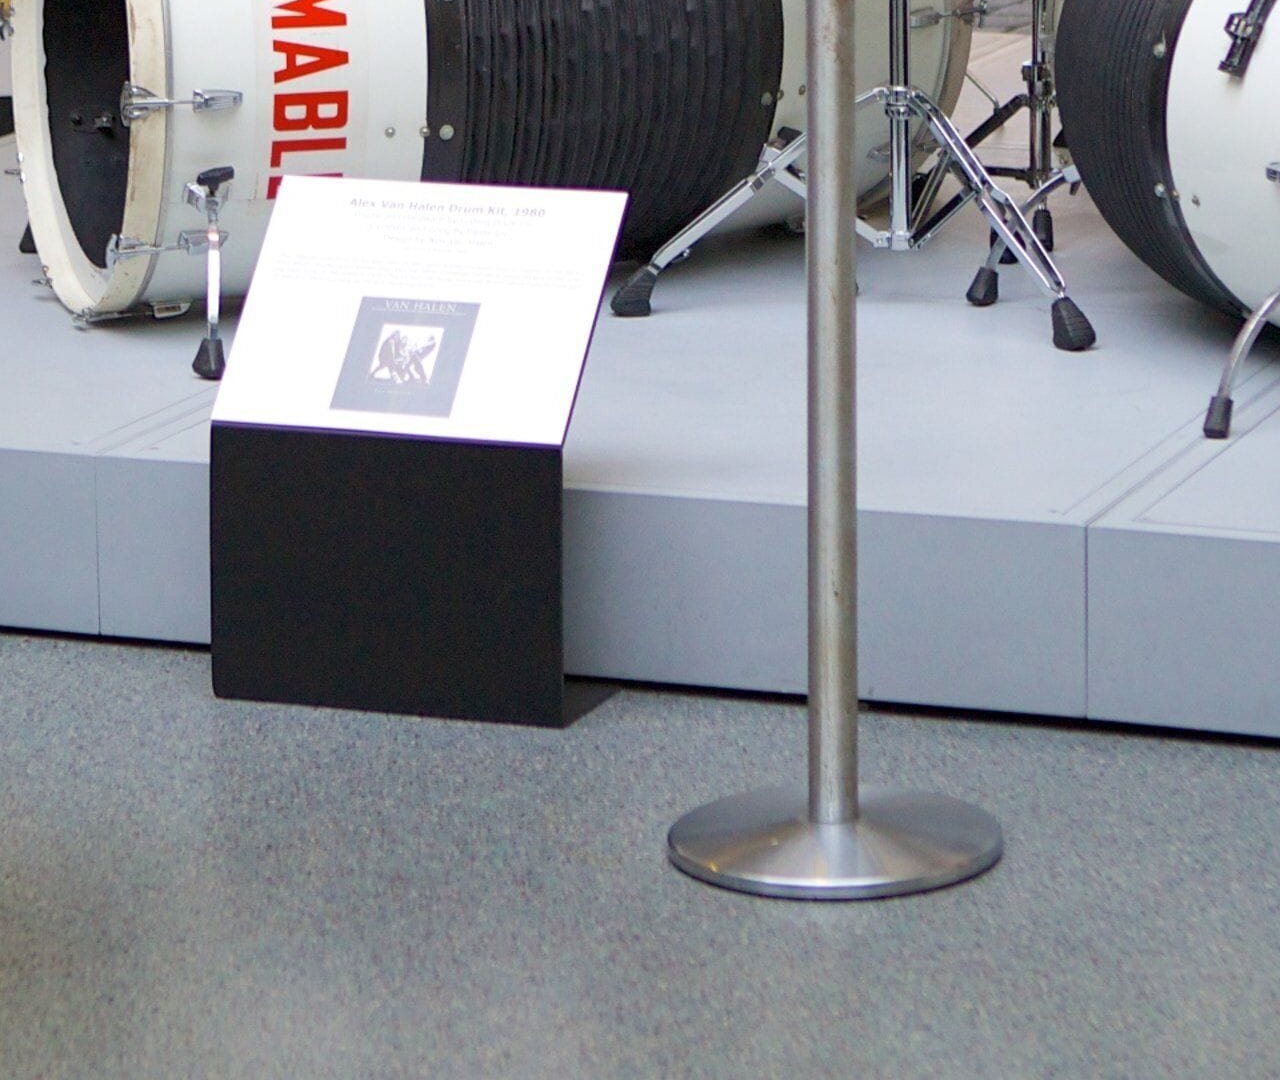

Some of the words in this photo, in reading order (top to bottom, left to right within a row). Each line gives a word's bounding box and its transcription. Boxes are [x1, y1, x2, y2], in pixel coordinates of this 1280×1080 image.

[350, 198, 376, 208] Alex
[381, 199, 405, 210] Van
[408, 201, 445, 212] Halen
[448, 203, 484, 214] Drum
[515, 207, 546, 218] 1980
[385, 299, 410, 311] VAN
[414, 302, 457, 313] HALEN
